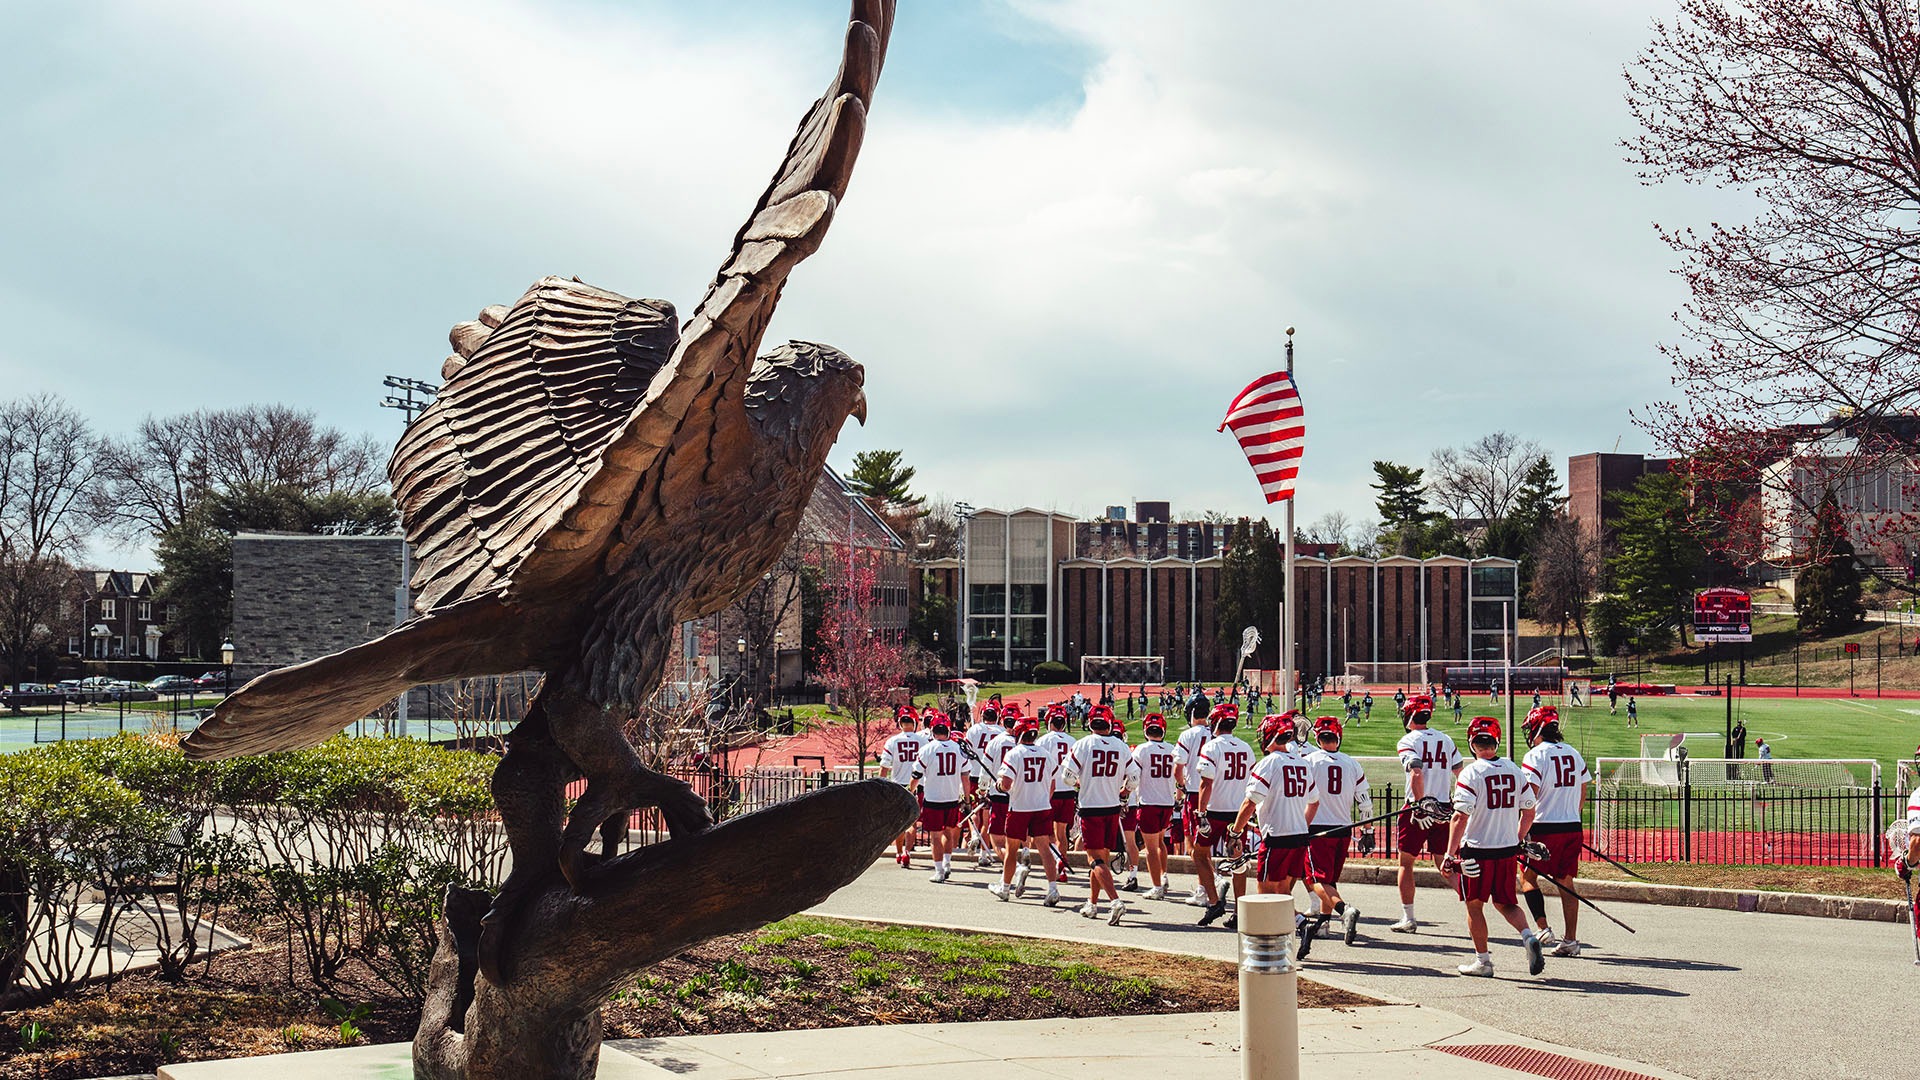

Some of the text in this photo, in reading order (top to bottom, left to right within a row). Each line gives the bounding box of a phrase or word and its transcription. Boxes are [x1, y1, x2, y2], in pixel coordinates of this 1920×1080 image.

[897, 741, 919, 762] 52
[936, 752, 957, 776] 10
[1092, 750, 1119, 777] 26
[1422, 741, 1447, 769] 44
[1023, 757, 1046, 782] 57
[1150, 754, 1174, 778] 56
[1224, 752, 1248, 780] 36
[1550, 755, 1575, 788] 12
[1283, 765, 1307, 798] 65
[1328, 765, 1343, 796] 8
[1485, 774, 1516, 809] 62
